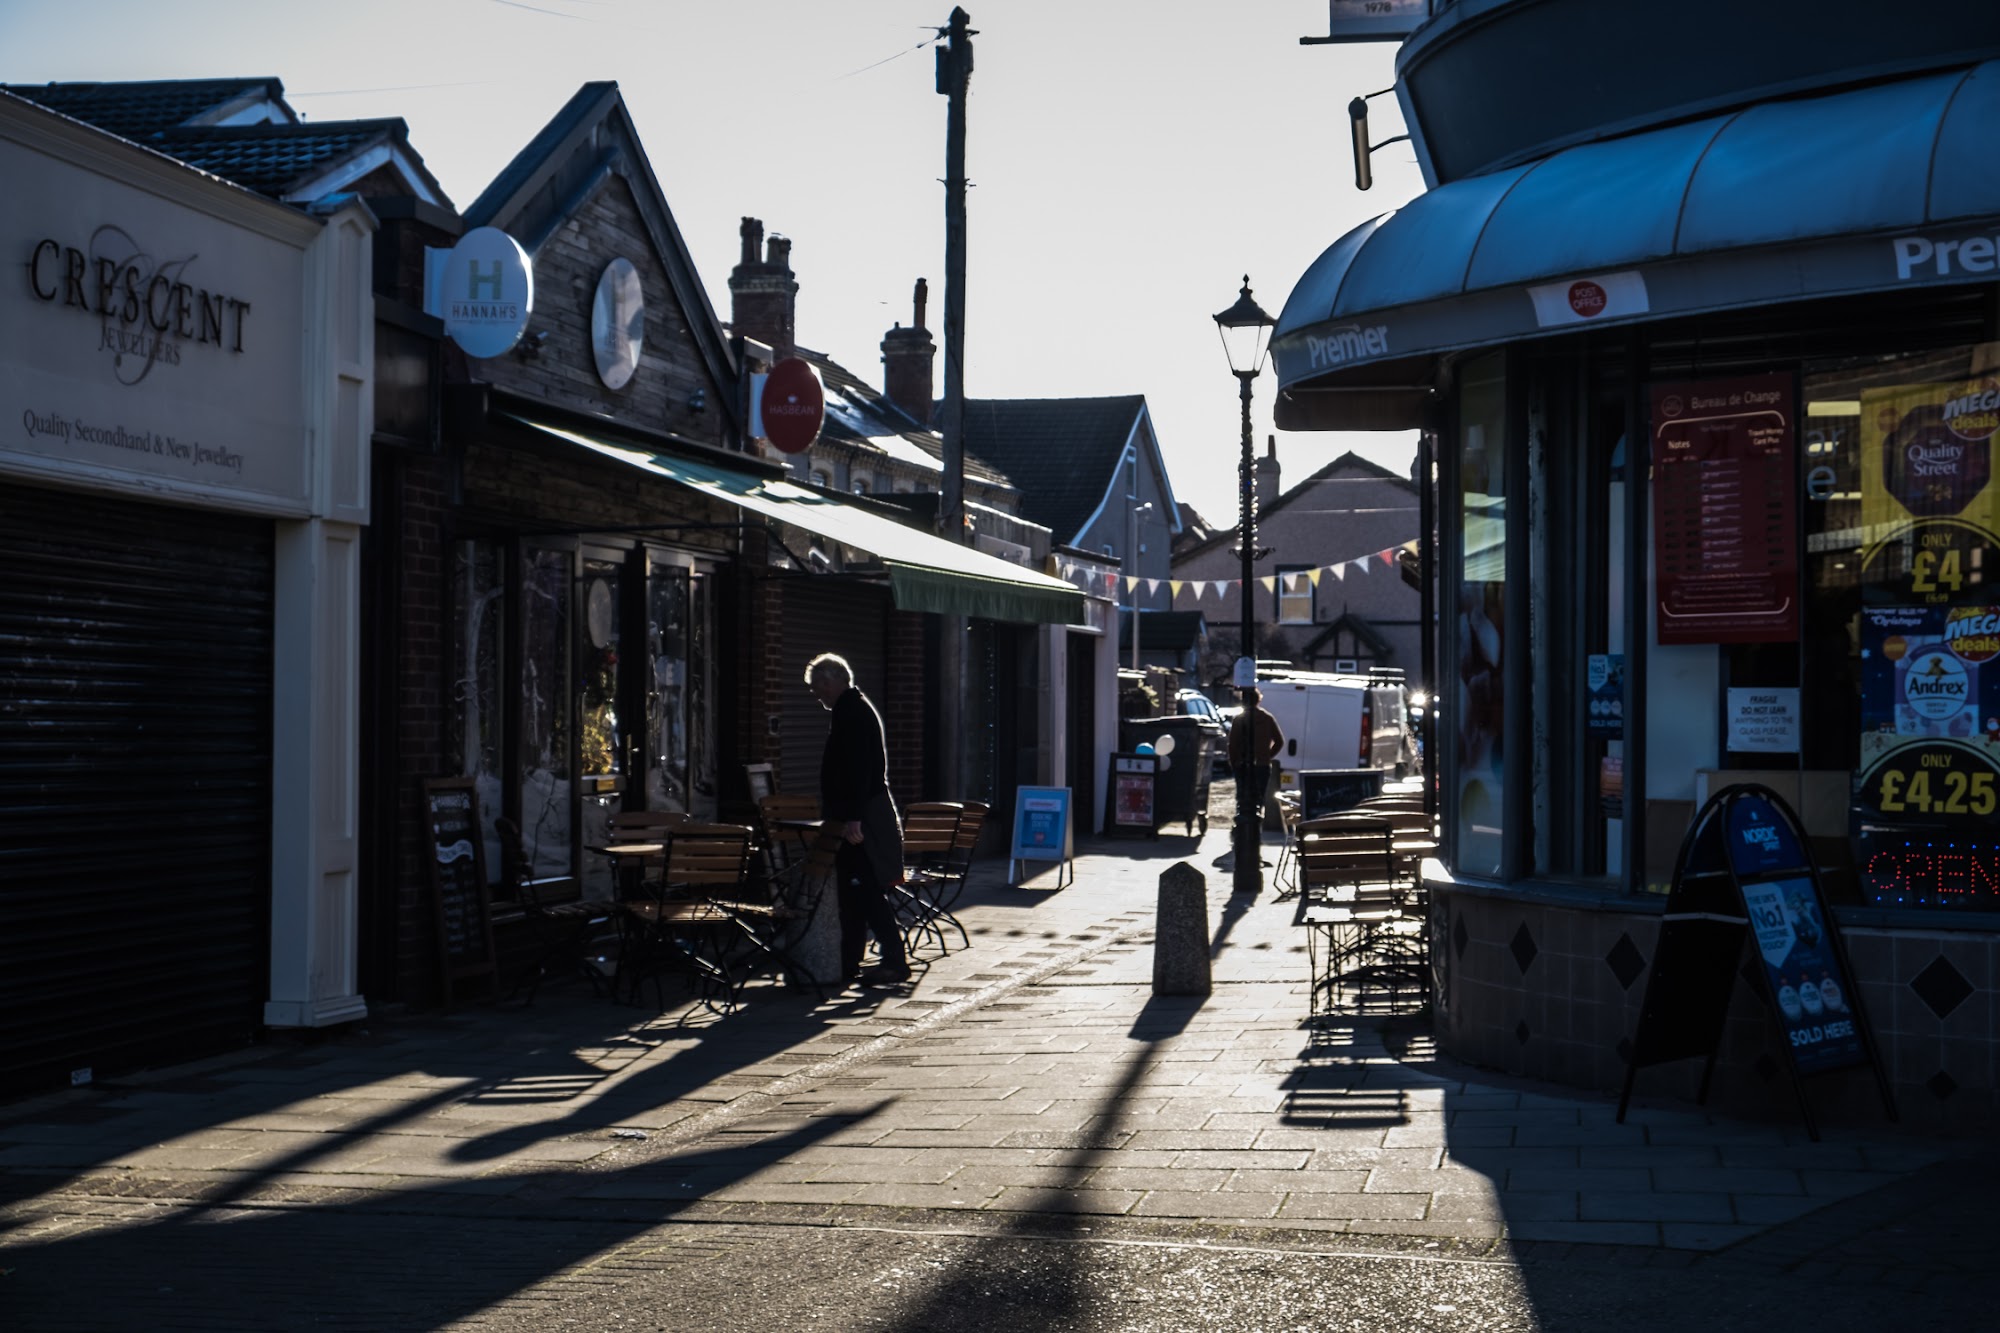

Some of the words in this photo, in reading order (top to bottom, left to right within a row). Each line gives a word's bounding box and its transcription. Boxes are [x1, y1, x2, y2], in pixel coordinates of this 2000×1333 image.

[1365, 2, 1392, 13] 1978
[1893, 235, 2000, 279] Pre
[469, 259, 502, 299] H
[31, 239, 250, 353] CRESCENT
[1574, 286, 1597, 299] POST
[453, 304, 517, 319] HANNAH'S
[1573, 296, 1603, 310] OFFICE
[98, 326, 180, 366] JEWELLERS
[1307, 324, 1389, 369] Premier
[1691, 396, 1727, 410] Bureau
[1729, 393, 1741, 405] de
[1744, 390, 1782, 404] Change
[769, 405, 815, 415] HASBEAN
[1951, 413, 1999, 430] deals
[24, 409, 72, 444] Quality
[75, 419, 150, 452] Secondhand
[153, 434, 164, 456] &
[166, 437, 191, 458] New
[193, 442, 244, 474] Jewellery
[1668, 440, 1691, 450] Notes
[1908, 444, 1964, 462] Quality
[1913, 461, 1959, 477] Street
[1921, 533, 1953, 548] ONLY
[1911, 549, 1964, 592] £4
[1952, 635, 2000, 652] deals
[1908, 678, 1965, 695] Andrex
[1750, 695, 1778, 704] FRAGILE
[1741, 706, 1752, 714] DO
[1753, 706, 1768, 714] NOT
[1769, 706, 1787, 714] LEAN
[1735, 716, 1769, 725] ANYTHING
[1770, 716, 1780, 724] TO
[1781, 715, 1793, 724] THE
[1739, 727, 1761, 735] GLASS
[1921, 753, 1953, 768] ONLY
[1879, 769, 1997, 815] £4.25
[1742, 826, 1778, 845] NORDIC
[1867, 850, 2000, 895] OPEN
[1751, 905, 1786, 930] No.1
[1789, 1026, 1823, 1047] SOLD
[1823, 1019, 1856, 1040] HERE
